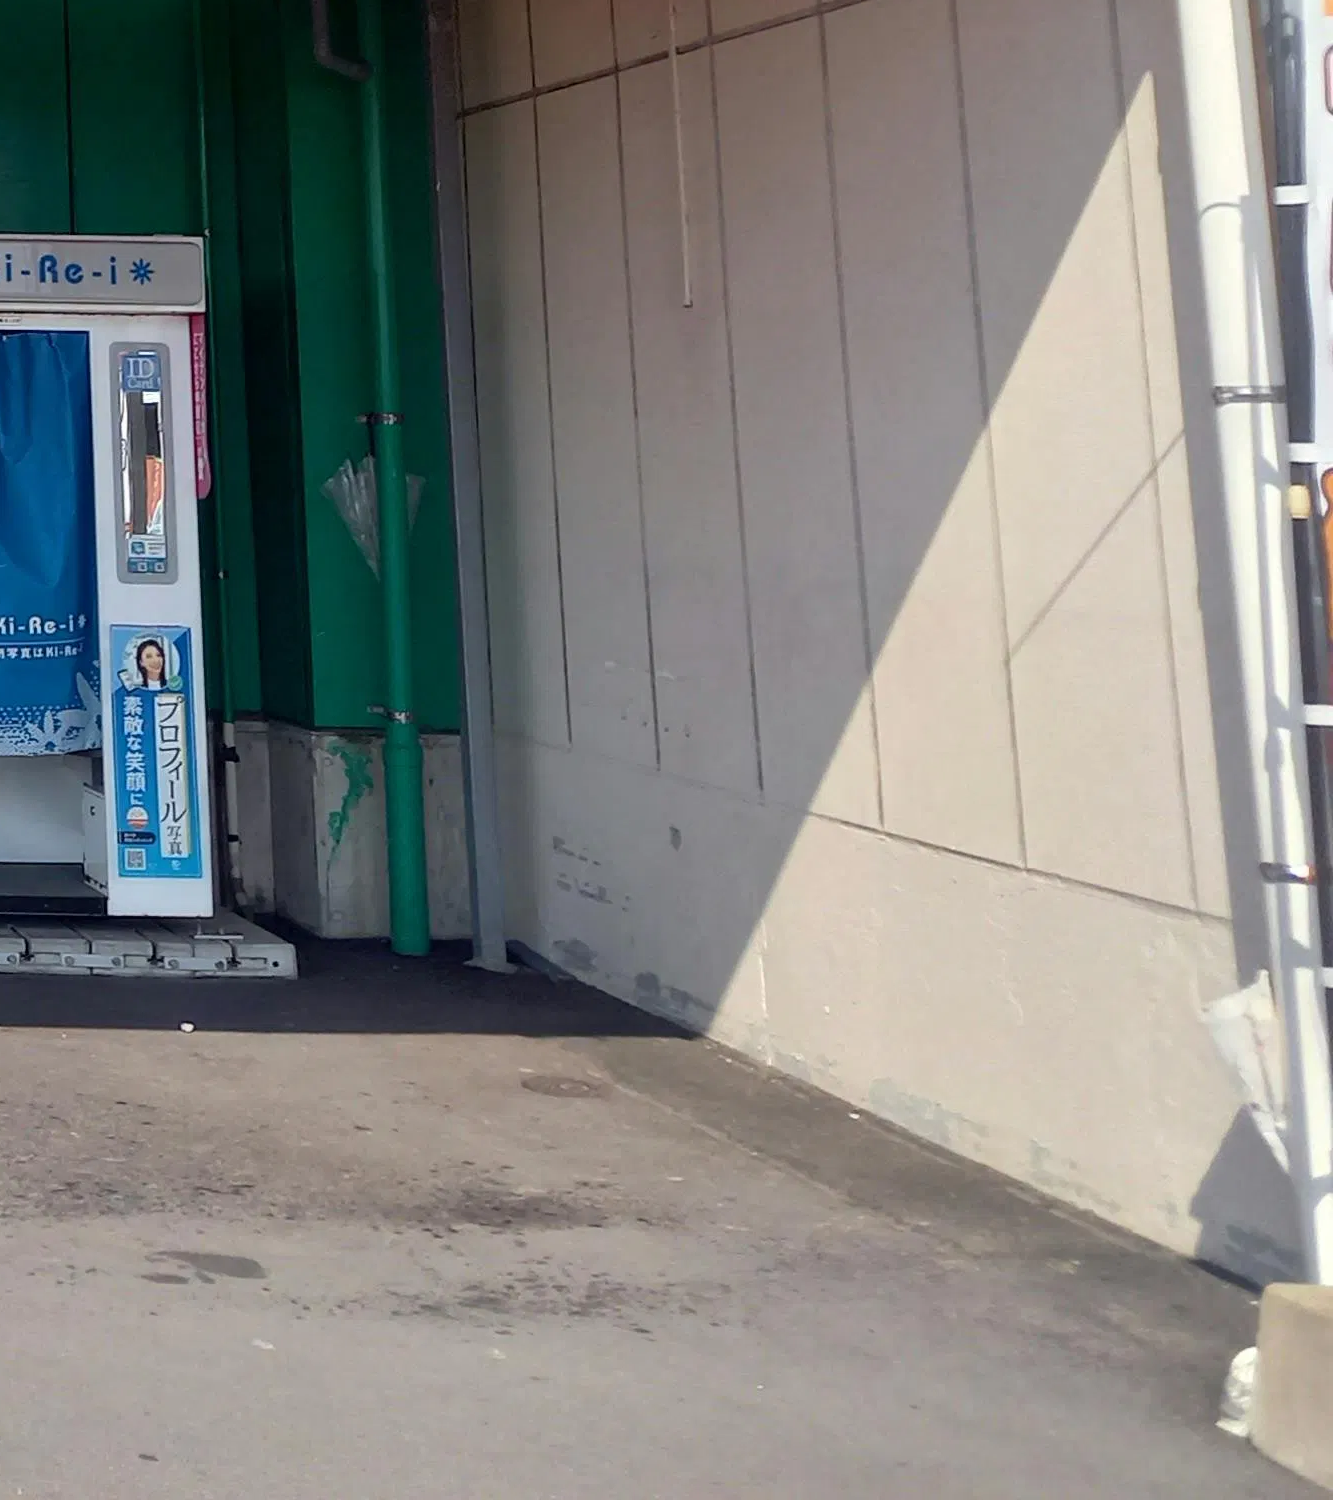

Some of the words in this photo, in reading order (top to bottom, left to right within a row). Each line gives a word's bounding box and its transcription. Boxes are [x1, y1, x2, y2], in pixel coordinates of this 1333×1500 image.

[123, 696, 147, 806] 素敵な笑顔に
[157, 694, 188, 856] プロフィール写真
